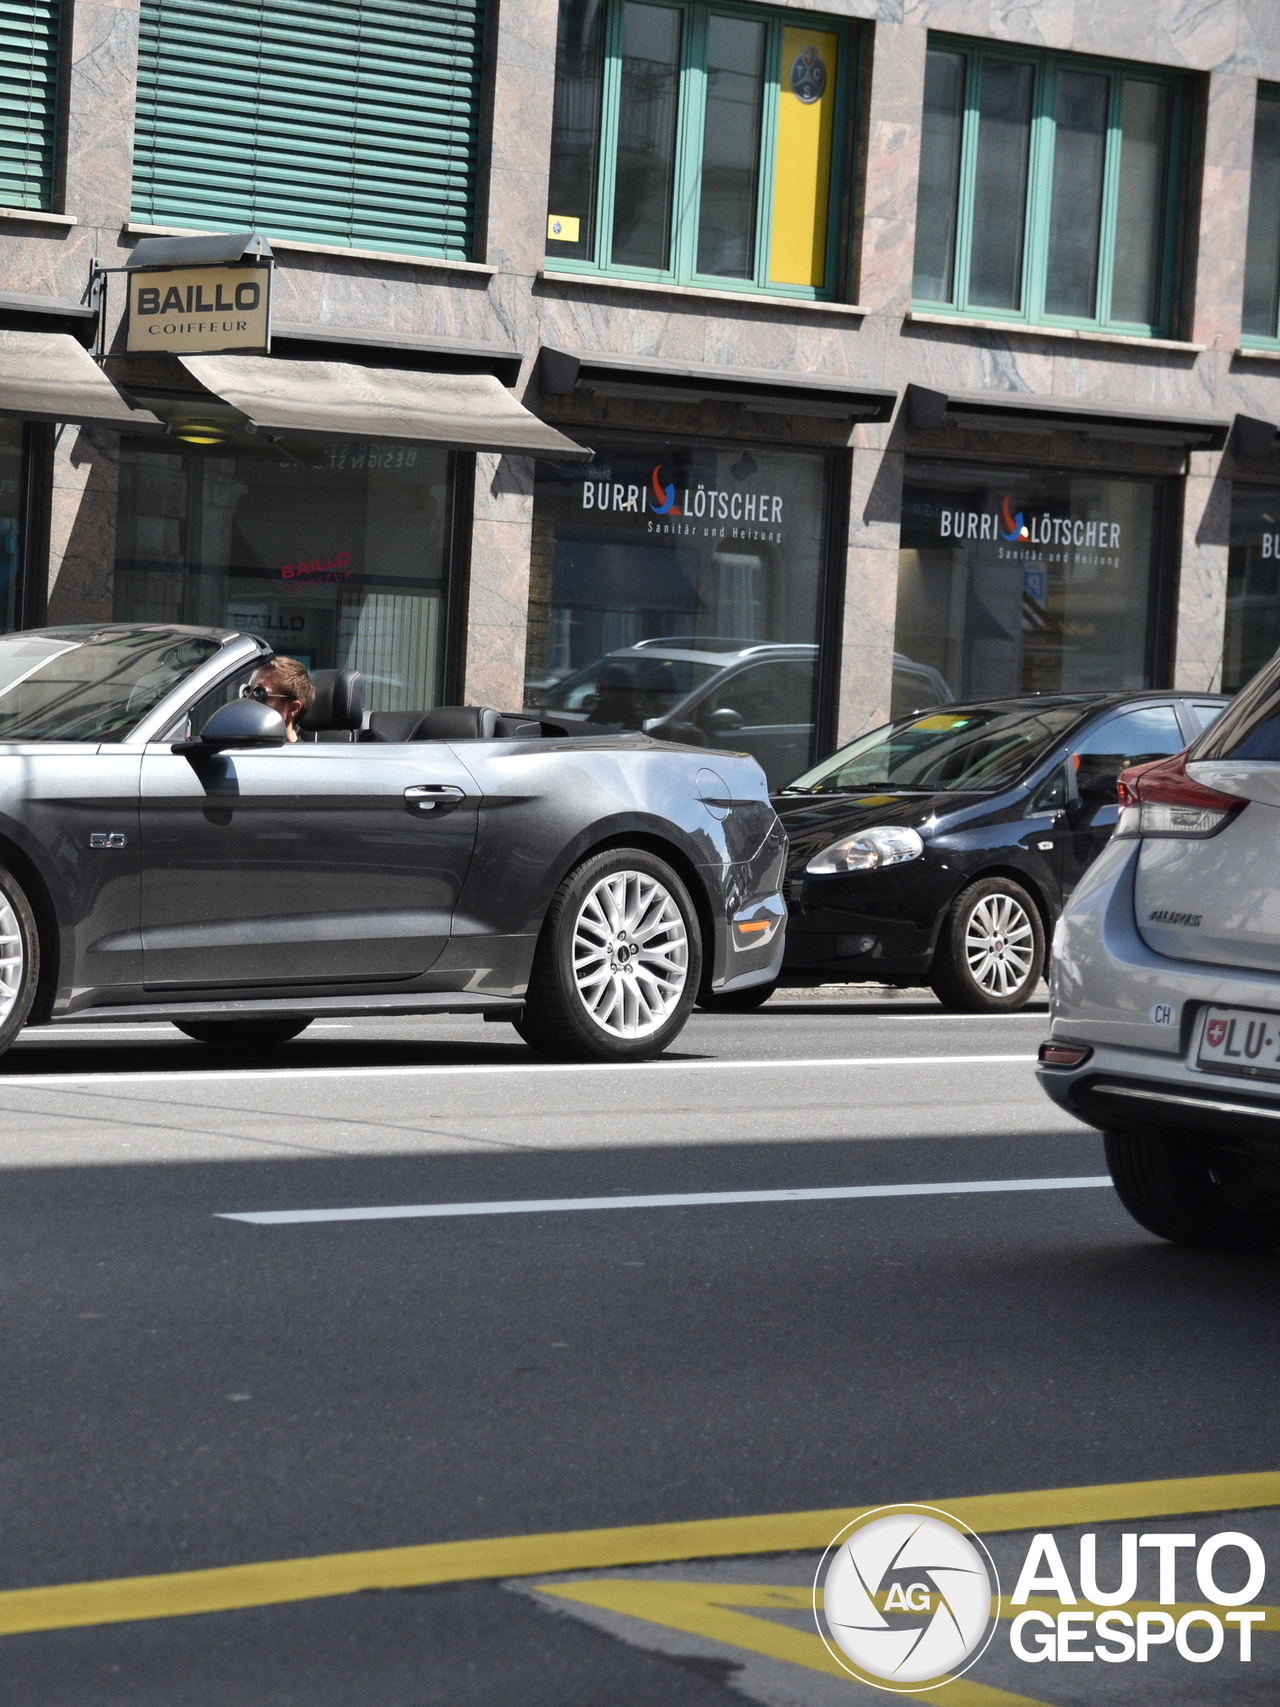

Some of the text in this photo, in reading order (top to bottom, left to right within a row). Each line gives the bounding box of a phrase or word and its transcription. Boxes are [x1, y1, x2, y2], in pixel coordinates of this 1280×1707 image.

[137, 282, 260, 315] BAILLO
[148, 320, 247, 335] COIFFEUR
[582, 481, 783, 523] BURRI LÖTSCHER
[647, 521, 782, 544] Sanitär und Heizung
[940, 510, 1121, 549] BURRI LÖTSCHER
[281, 551, 352, 580] BAILLO
[998, 547, 1120, 568] Sanitär und Heizung
[1148, 910, 1202, 927] AURIS
[1154, 1005, 1171, 1025] CH
